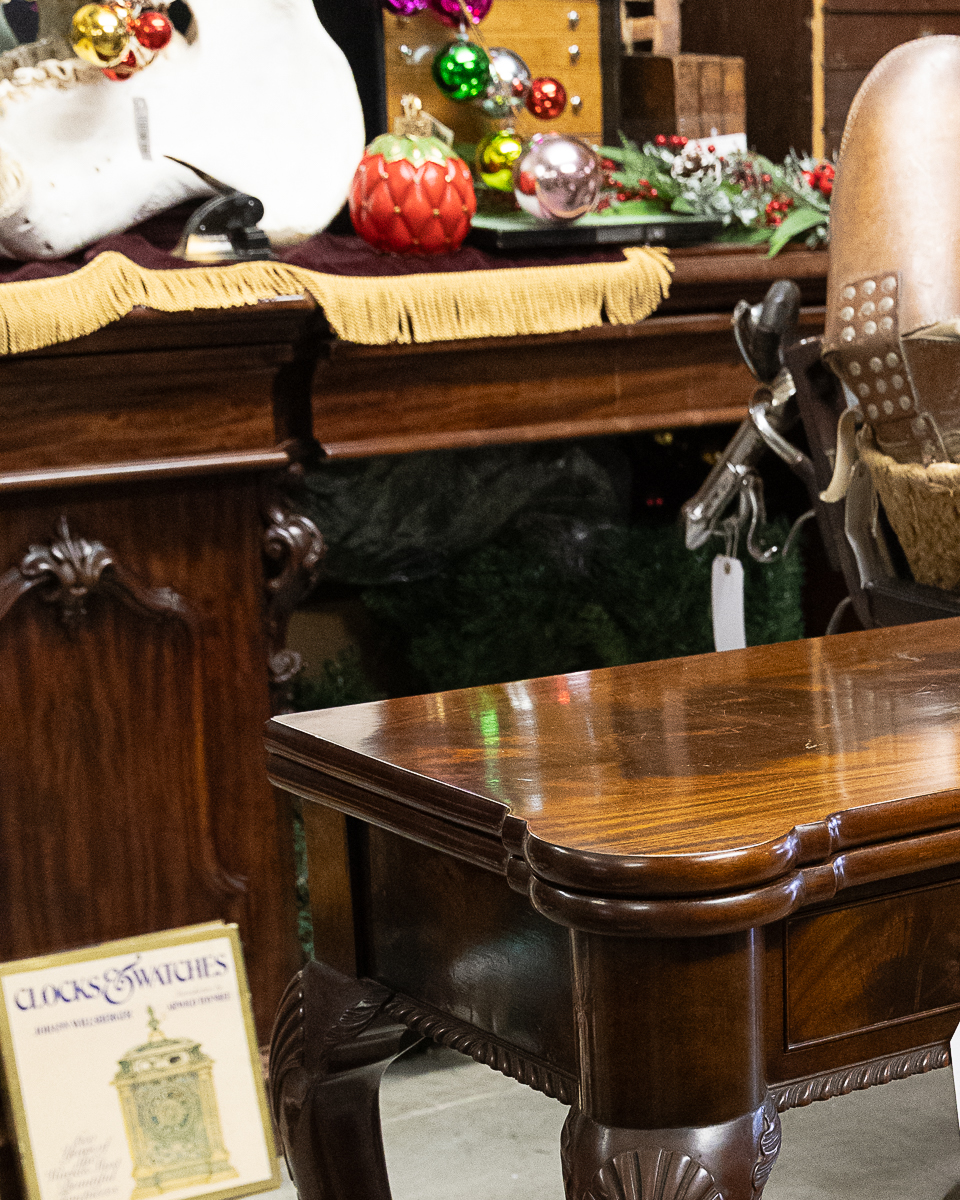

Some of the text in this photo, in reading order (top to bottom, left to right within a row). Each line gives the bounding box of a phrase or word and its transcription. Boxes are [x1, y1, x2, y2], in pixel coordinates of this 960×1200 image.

[14, 975, 101, 1010] CLOCKS
[103, 951, 141, 1005] &
[133, 954, 228, 988] WATCHES
